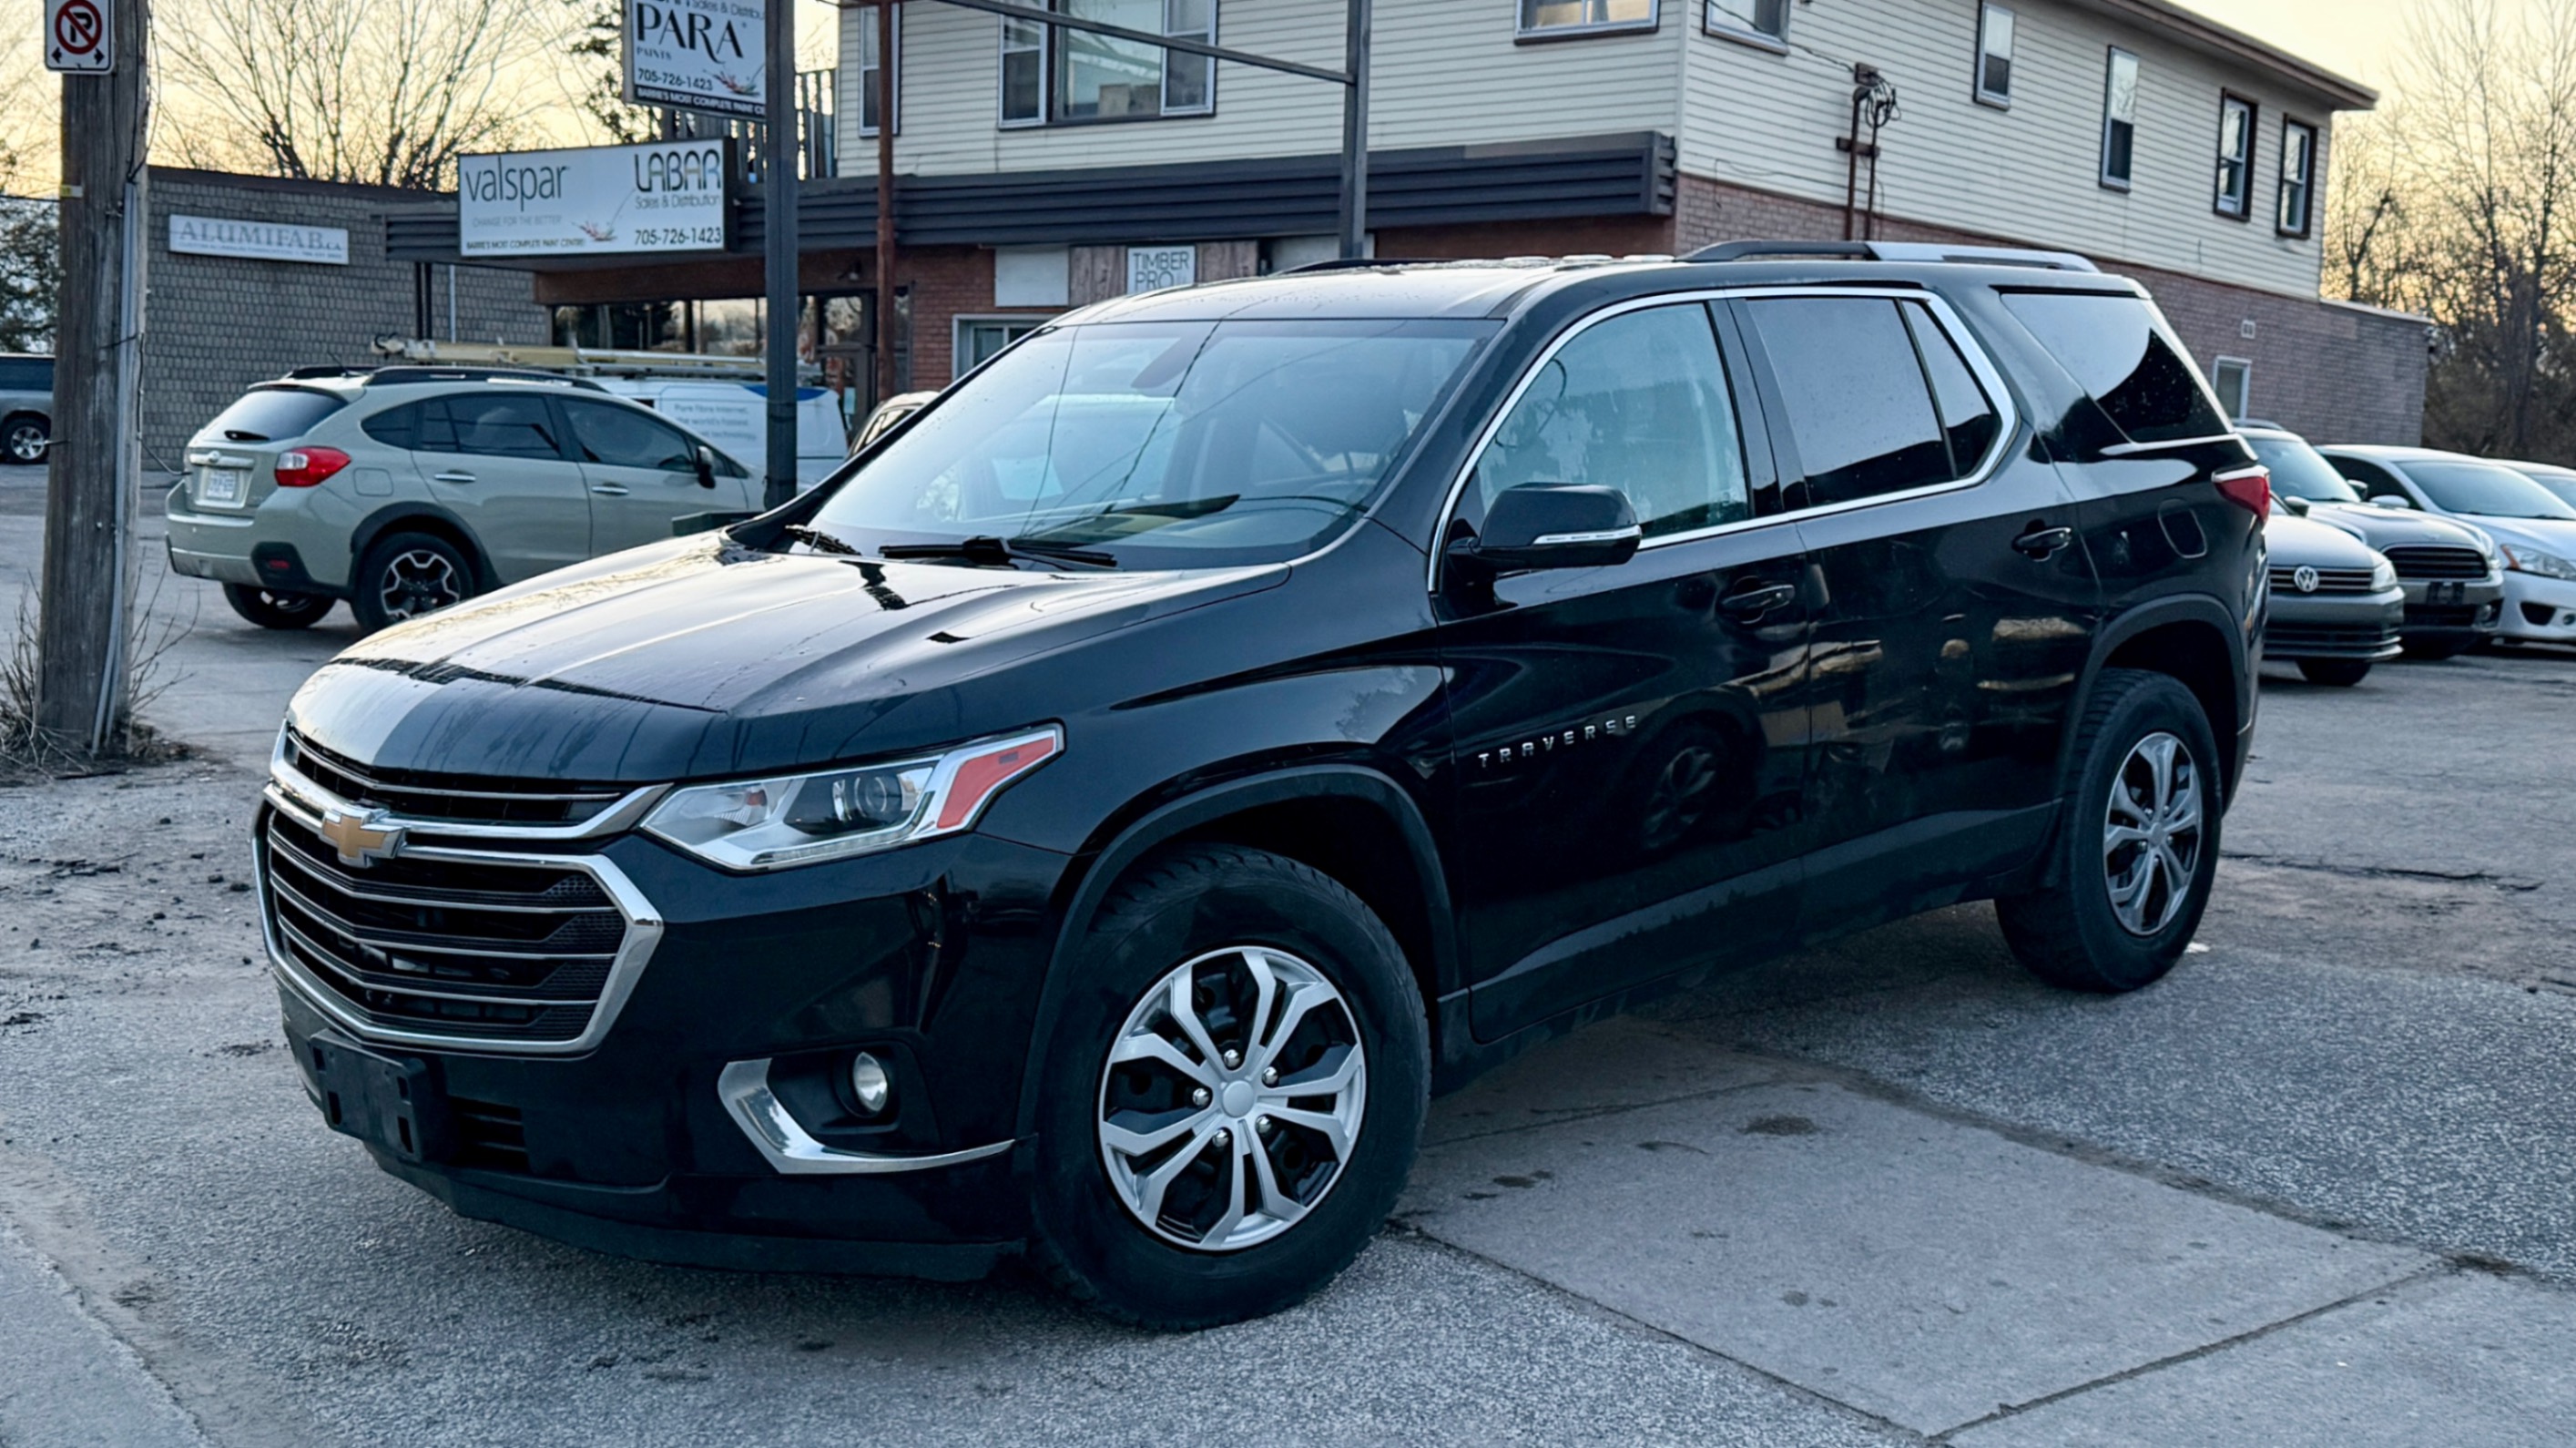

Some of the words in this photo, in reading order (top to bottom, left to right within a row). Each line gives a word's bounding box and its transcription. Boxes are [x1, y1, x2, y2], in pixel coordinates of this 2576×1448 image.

[637, 3, 744, 64] PARA
[638, 68, 713, 90] 705-726-1423
[670, 92, 692, 105] MOST
[693, 97, 732, 110] COMPLETE
[634, 148, 721, 192] LABAR
[465, 156, 567, 212] valspar
[635, 195, 659, 209] Sales
[661, 194, 669, 209] &
[671, 193, 720, 209] Distribution
[473, 216, 500, 228] CHANGE
[503, 216, 517, 227] FOR
[519, 215, 532, 226] THE
[534, 215, 562, 226] BETTER
[492, 240, 509, 249] MOST
[510, 239, 541, 249] COMPLETE
[635, 227, 722, 245] 705-726-1423
[1133, 250, 1189, 270] TIMBER
[1135, 270, 1174, 291] PRO
[1478, 715, 1636, 768] TRAVERSE
